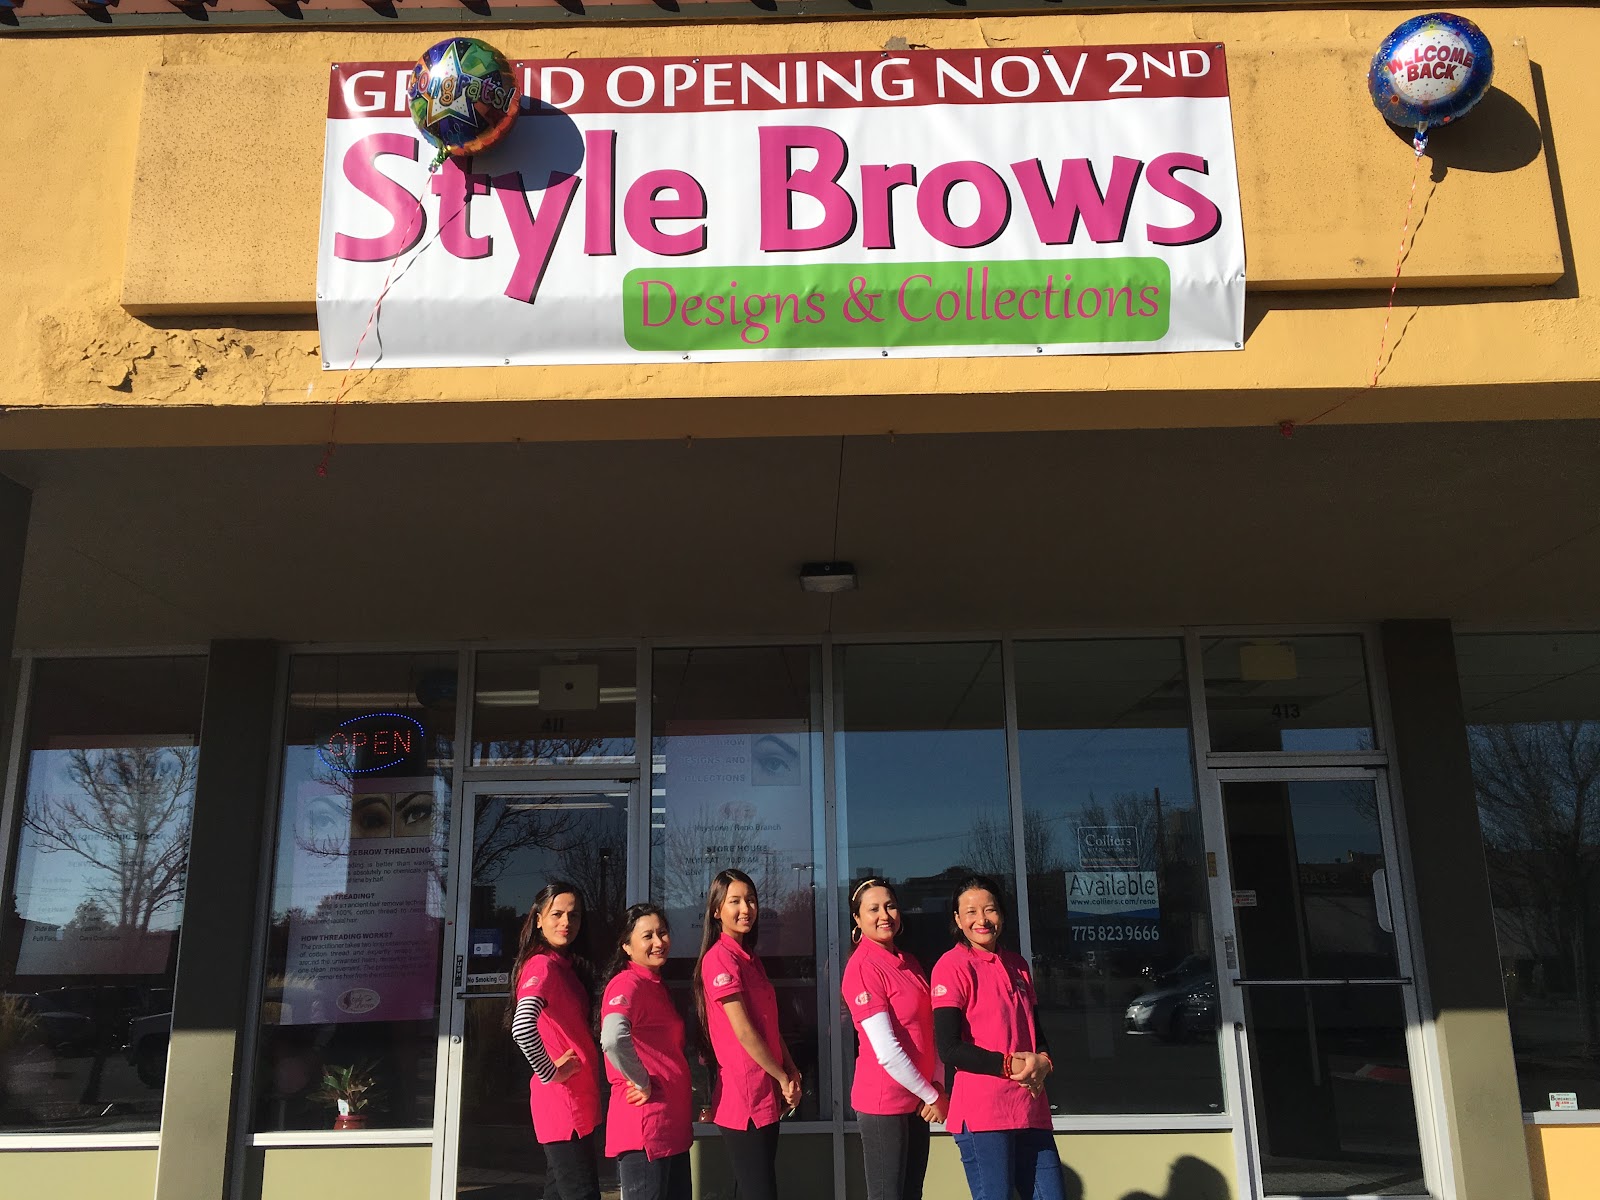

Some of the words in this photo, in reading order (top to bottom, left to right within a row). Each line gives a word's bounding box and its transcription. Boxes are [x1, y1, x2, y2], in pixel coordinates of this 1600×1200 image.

[606, 57, 914, 108] OPENING
[936, 53, 1089, 98] NOV
[1105, 49, 1212, 93] 2ND
[1407, 62, 1458, 82] BACK
[408, 63, 517, 113] Congrats!
[334, 129, 707, 304] Style
[758, 126, 1222, 252] Brows
[636, 280, 826, 344] Designs
[843, 275, 885, 323] &
[898, 267, 1160, 322] Collections
[1272, 703, 1300, 719] 413
[329, 730, 411, 756] OPEN
[756, 823, 782, 831] Branch
[1085, 834, 1132, 846] Colliers
[1069, 874, 1155, 896] Available
[1070, 897, 1156, 906] www.colliers.com/reno
[320, 933, 362, 941] THREADING
[1072, 926, 1096, 941] 775
[1098, 926, 1123, 941] 823
[1125, 926, 1159, 941] 9666
